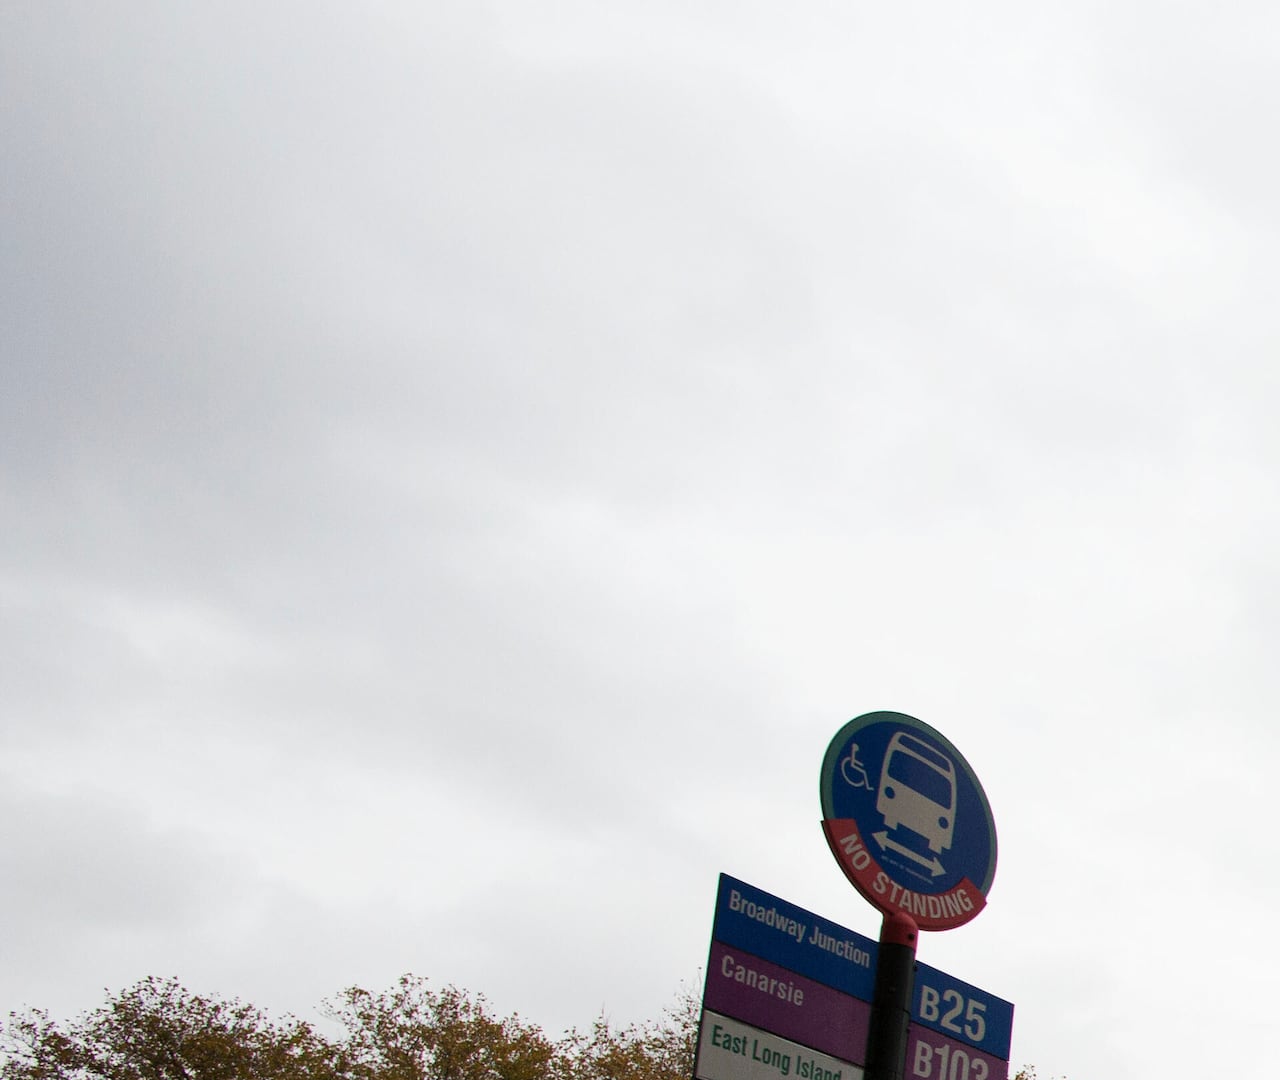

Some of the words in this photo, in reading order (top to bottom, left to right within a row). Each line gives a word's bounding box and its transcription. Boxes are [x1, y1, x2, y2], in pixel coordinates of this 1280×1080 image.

[839, 833, 871, 871] NO
[872, 871, 974, 919] STANDING
[729, 889, 806, 943] Broadway
[809, 926, 871, 968] Junction
[721, 955, 804, 1007] Canarsie
[919, 985, 987, 1042] B25
[711, 1025, 748, 1056] East
[752, 1040, 791, 1076] Long
